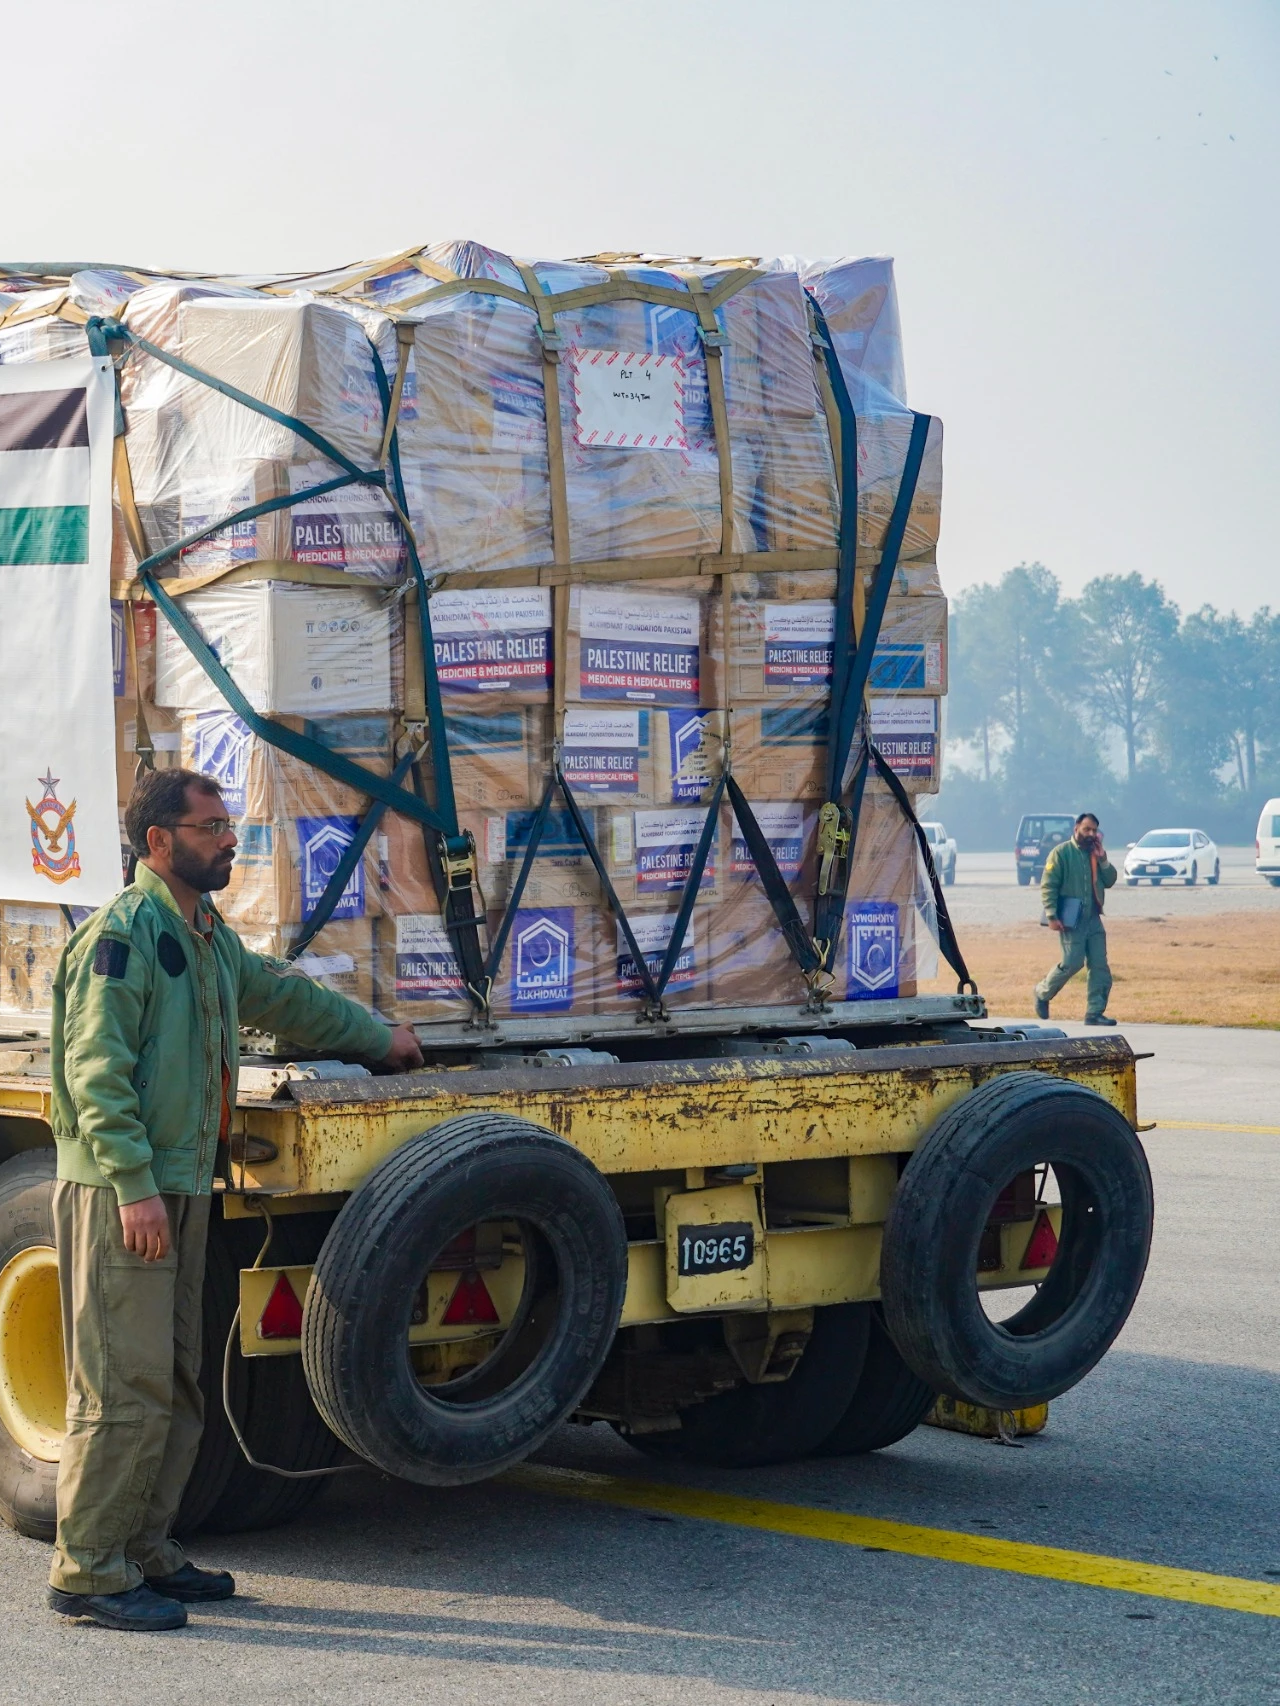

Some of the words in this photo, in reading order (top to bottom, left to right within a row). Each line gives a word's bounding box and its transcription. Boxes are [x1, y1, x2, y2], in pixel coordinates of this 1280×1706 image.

[295, 524, 372, 546] PALESTINE
[297, 551, 343, 562] MEDICINE
[352, 549, 391, 559] MEDICAL
[515, 610, 544, 619] PAKISTAN
[663, 626, 692, 635] PAKISTAN
[434, 640, 504, 663] PALESTINE
[507, 638, 546, 659] RELIEF
[769, 650, 808, 663] PALESTINE
[810, 650, 833, 664] RELIEF
[587, 648, 651, 672] PALESTINE
[653, 652, 692, 674] RELIEF
[436, 667, 477, 679] MEDICINE
[479, 666, 484, 677] &
[486, 664, 522, 676] MEDICAL
[523, 663, 547, 674] ITEMS
[587, 674, 626, 686] MEDICINE
[627, 677, 632, 686] &
[633, 676, 669, 689] MEDICAL
[669, 679, 692, 689] ITEMS
[909, 741, 931, 754] RELIEF
[564, 756, 606, 770] PALESTINE
[608, 756, 634, 770] RELIEF
[565, 773, 590, 781] MEDICINE
[594, 773, 618, 781] MEDICAL
[618, 773, 634, 781] ITEMS
[641, 853, 683, 869] PALESTINE
[642, 872, 667, 880] MEDICINE
[852, 913, 895, 923] ALKHIDMAT
[401, 961, 447, 977] PALESTINE
[401, 980, 429, 988] MEDICINE
[517, 989, 568, 1000] ALKHIDMAT
